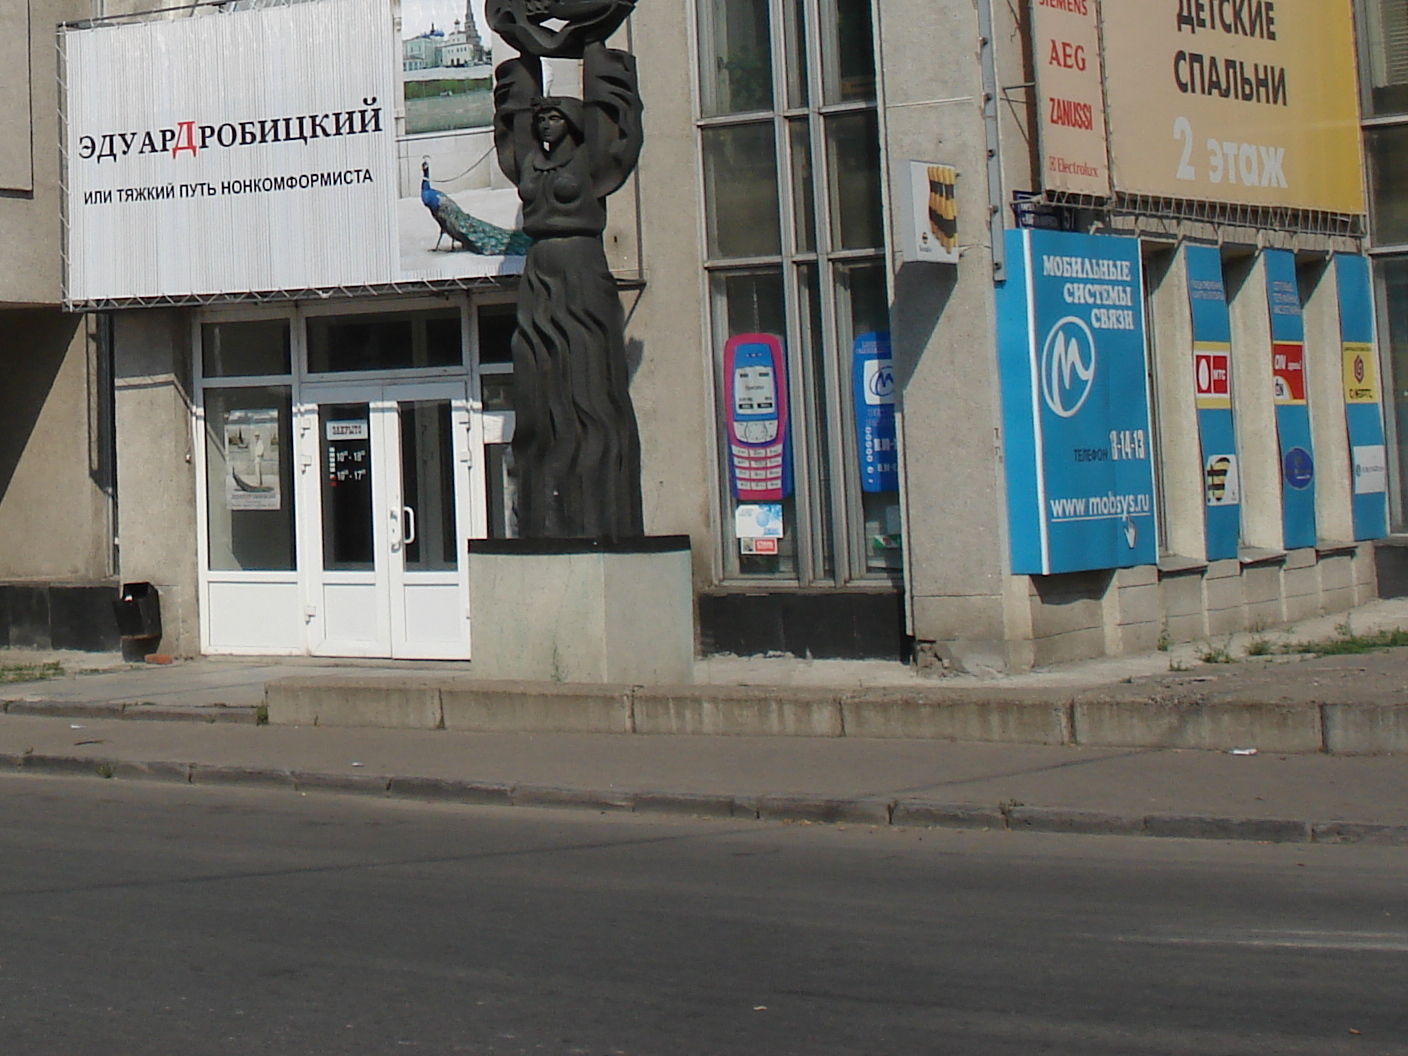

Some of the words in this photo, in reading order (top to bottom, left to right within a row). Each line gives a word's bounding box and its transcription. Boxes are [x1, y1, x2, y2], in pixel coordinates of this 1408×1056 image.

[1049, 39, 1087, 71] AEG
[1173, 49, 1288, 107] СПАЛЬНИ
[1049, 97, 1093, 131] ZANUSSI
[1172, 115, 1196, 181] 2
[1057, 157, 1099, 178] Electrolux
[83, 190, 113, 205] ИЛИ
[116, 182, 176, 203] ТЯЖКИЙ
[179, 182, 217, 198] ПУТЬ
[220, 168, 374, 195] НОНКОМФОРМИСТА
[1042, 255, 1131, 281] МОБИЛЬНЫЕ
[1063, 282, 1132, 306] СИСТЕМЫ
[1091, 308, 1134, 330] СВЯЗИ
